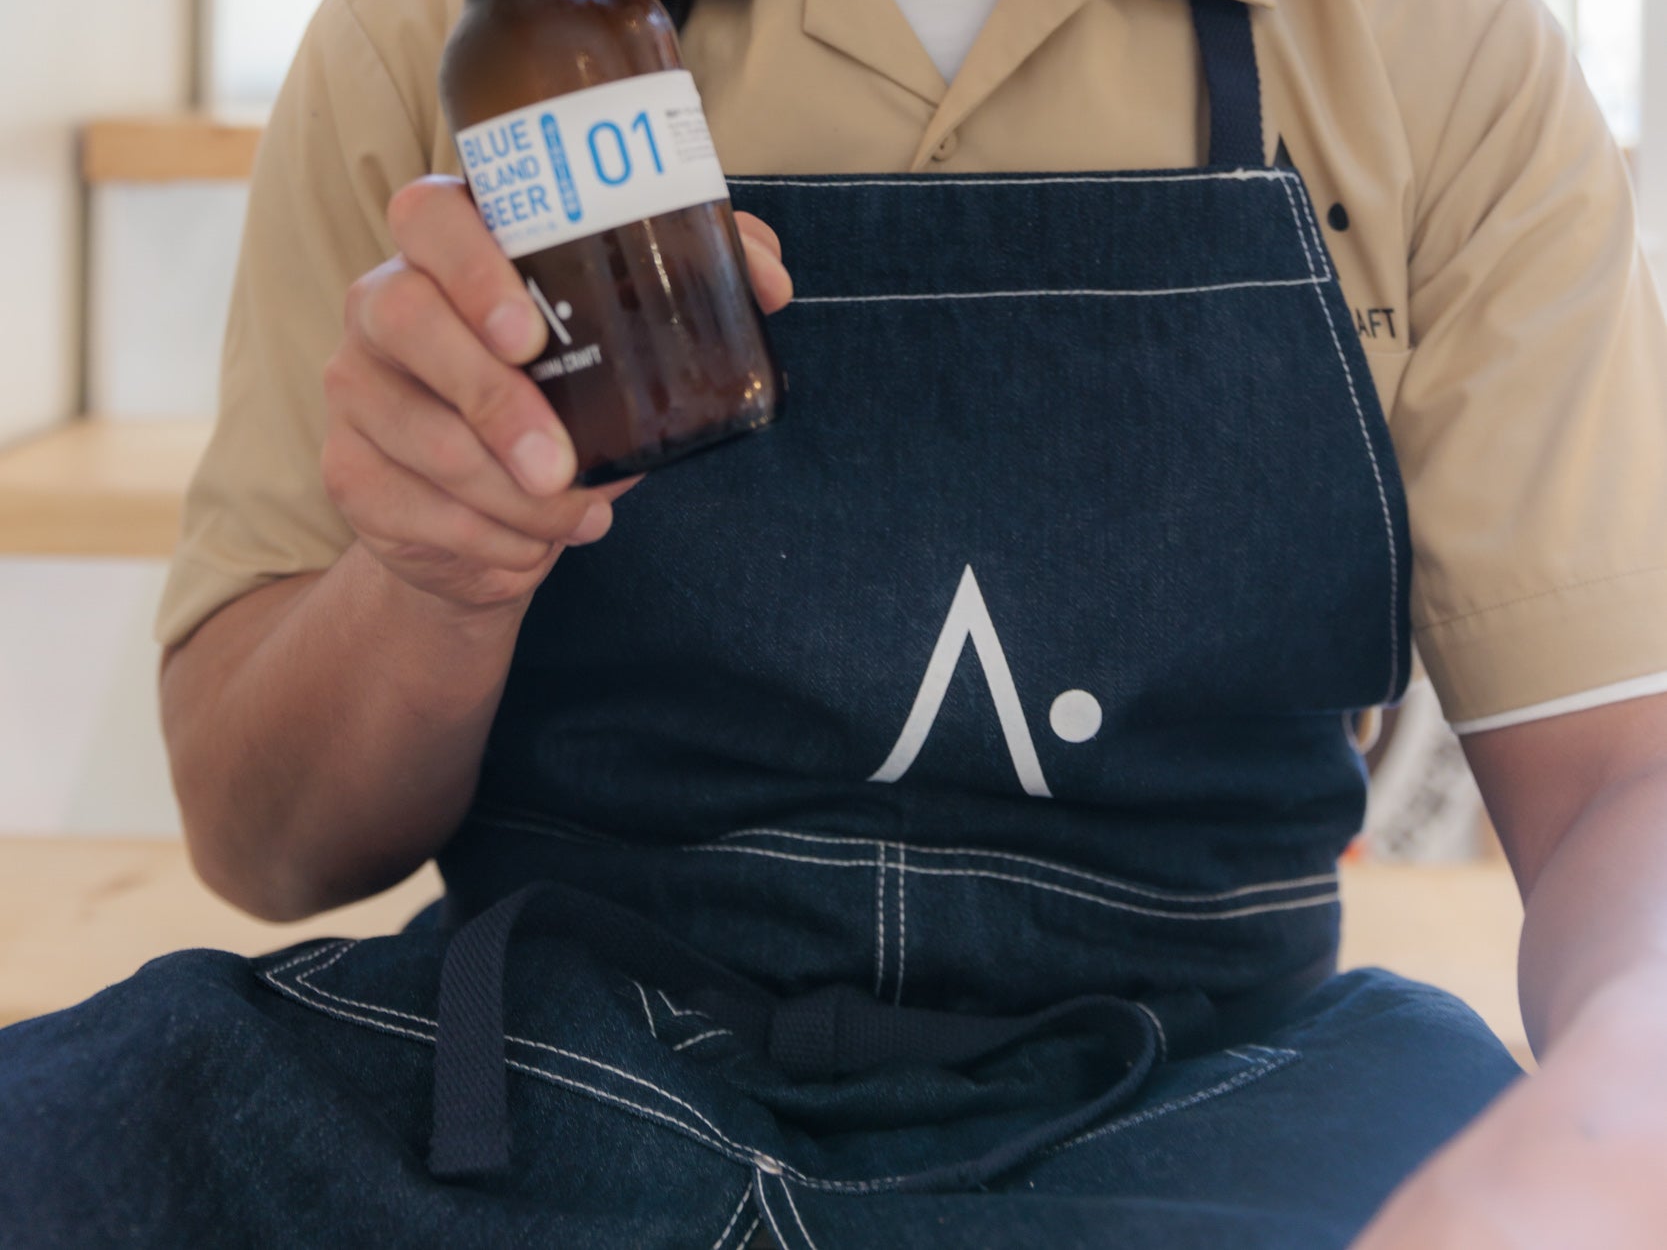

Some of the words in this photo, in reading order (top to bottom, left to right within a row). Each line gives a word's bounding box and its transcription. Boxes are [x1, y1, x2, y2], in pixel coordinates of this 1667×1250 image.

[463, 119, 533, 169] BLUE
[586, 110, 665, 188] 01
[480, 184, 551, 232] BEER
